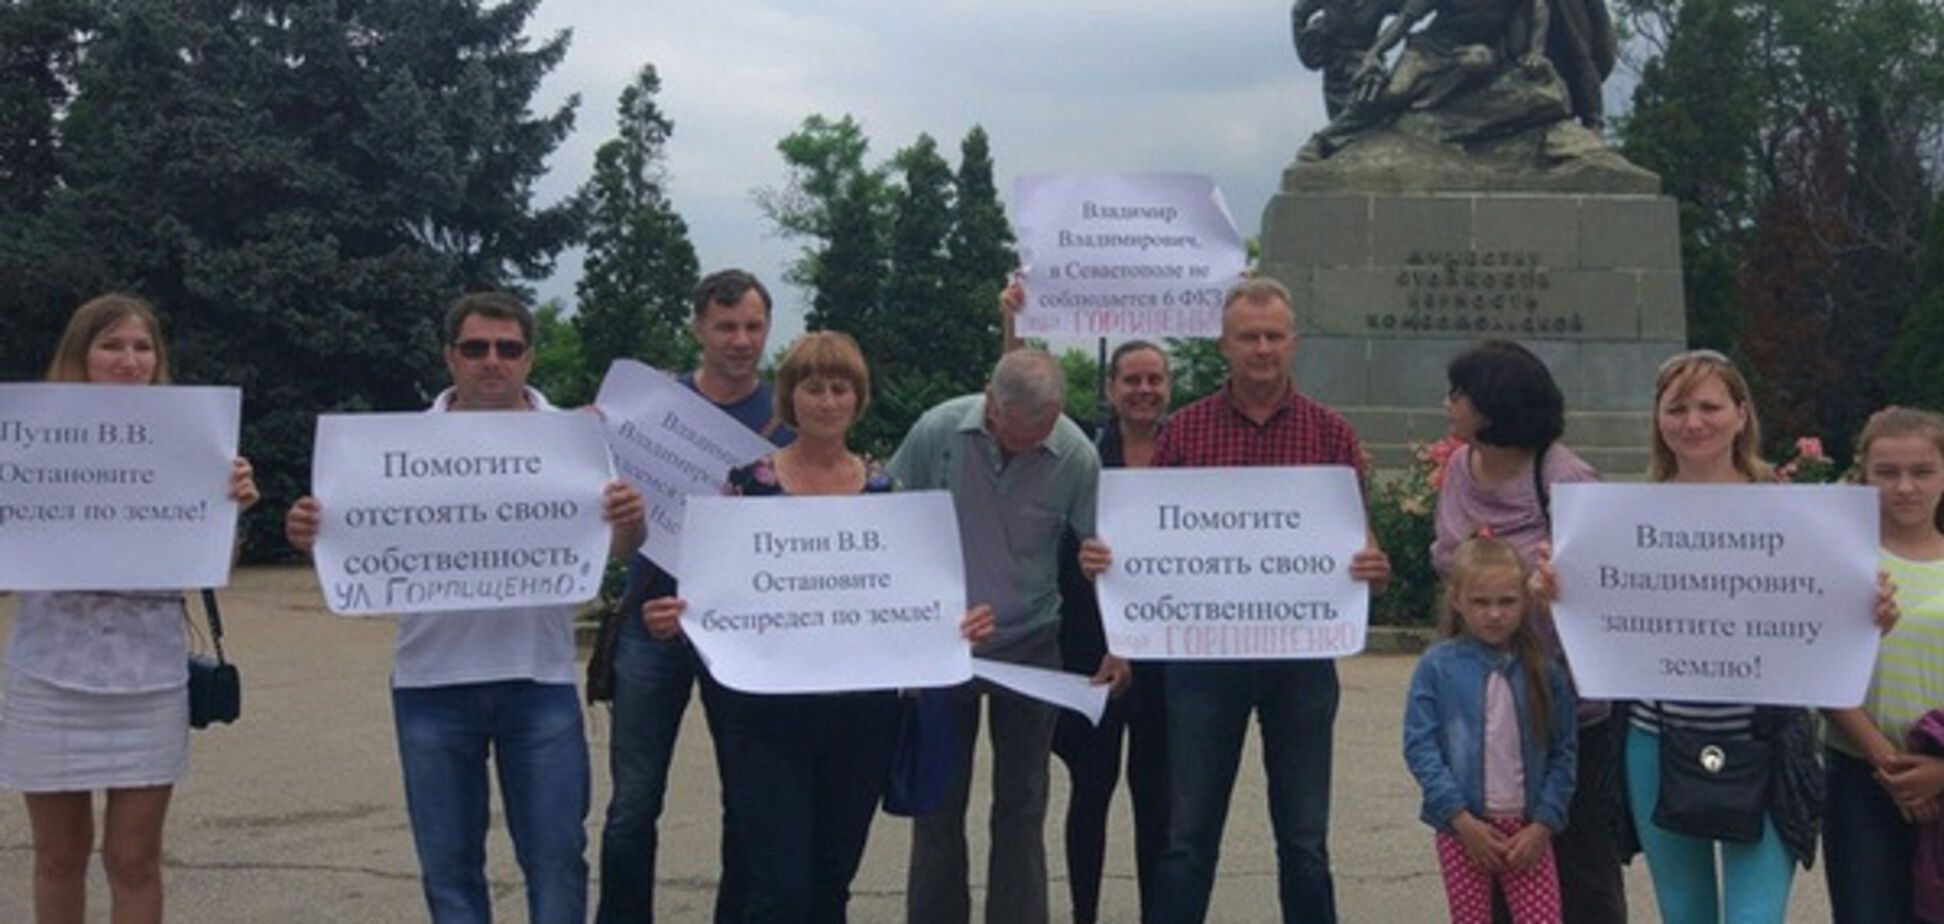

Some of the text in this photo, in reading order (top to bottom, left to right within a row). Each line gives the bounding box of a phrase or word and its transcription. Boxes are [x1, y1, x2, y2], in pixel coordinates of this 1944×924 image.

[1082, 202, 1178, 223] Владимир
[1058, 229, 1202, 249] Владимирович,
[1065, 261, 1184, 279] Севастополе
[1188, 265, 1210, 279] не
[1038, 287, 1158, 308] соблюдается
[0, 421, 153, 448] Путин В.В.
[0, 462, 155, 484] Остановите
[383, 452, 542, 478] Помогите
[84, 503, 116, 520] по
[121, 500, 207, 521] земле!
[344, 499, 578, 527] отстоять свою
[1158, 505, 1302, 530] Помогите
[752, 530, 887, 558] Путин В.В.
[1636, 524, 1785, 557] Владимир
[1124, 553, 1336, 576] отстоять свою
[752, 570, 893, 593] Остановите
[1599, 564, 1824, 598] Владимирович,
[702, 601, 941, 635] беспредел по земле!
[1123, 594, 1339, 622] собственность
[1602, 612, 1824, 644] защитите нашу
[1659, 654, 1763, 680] землю!
